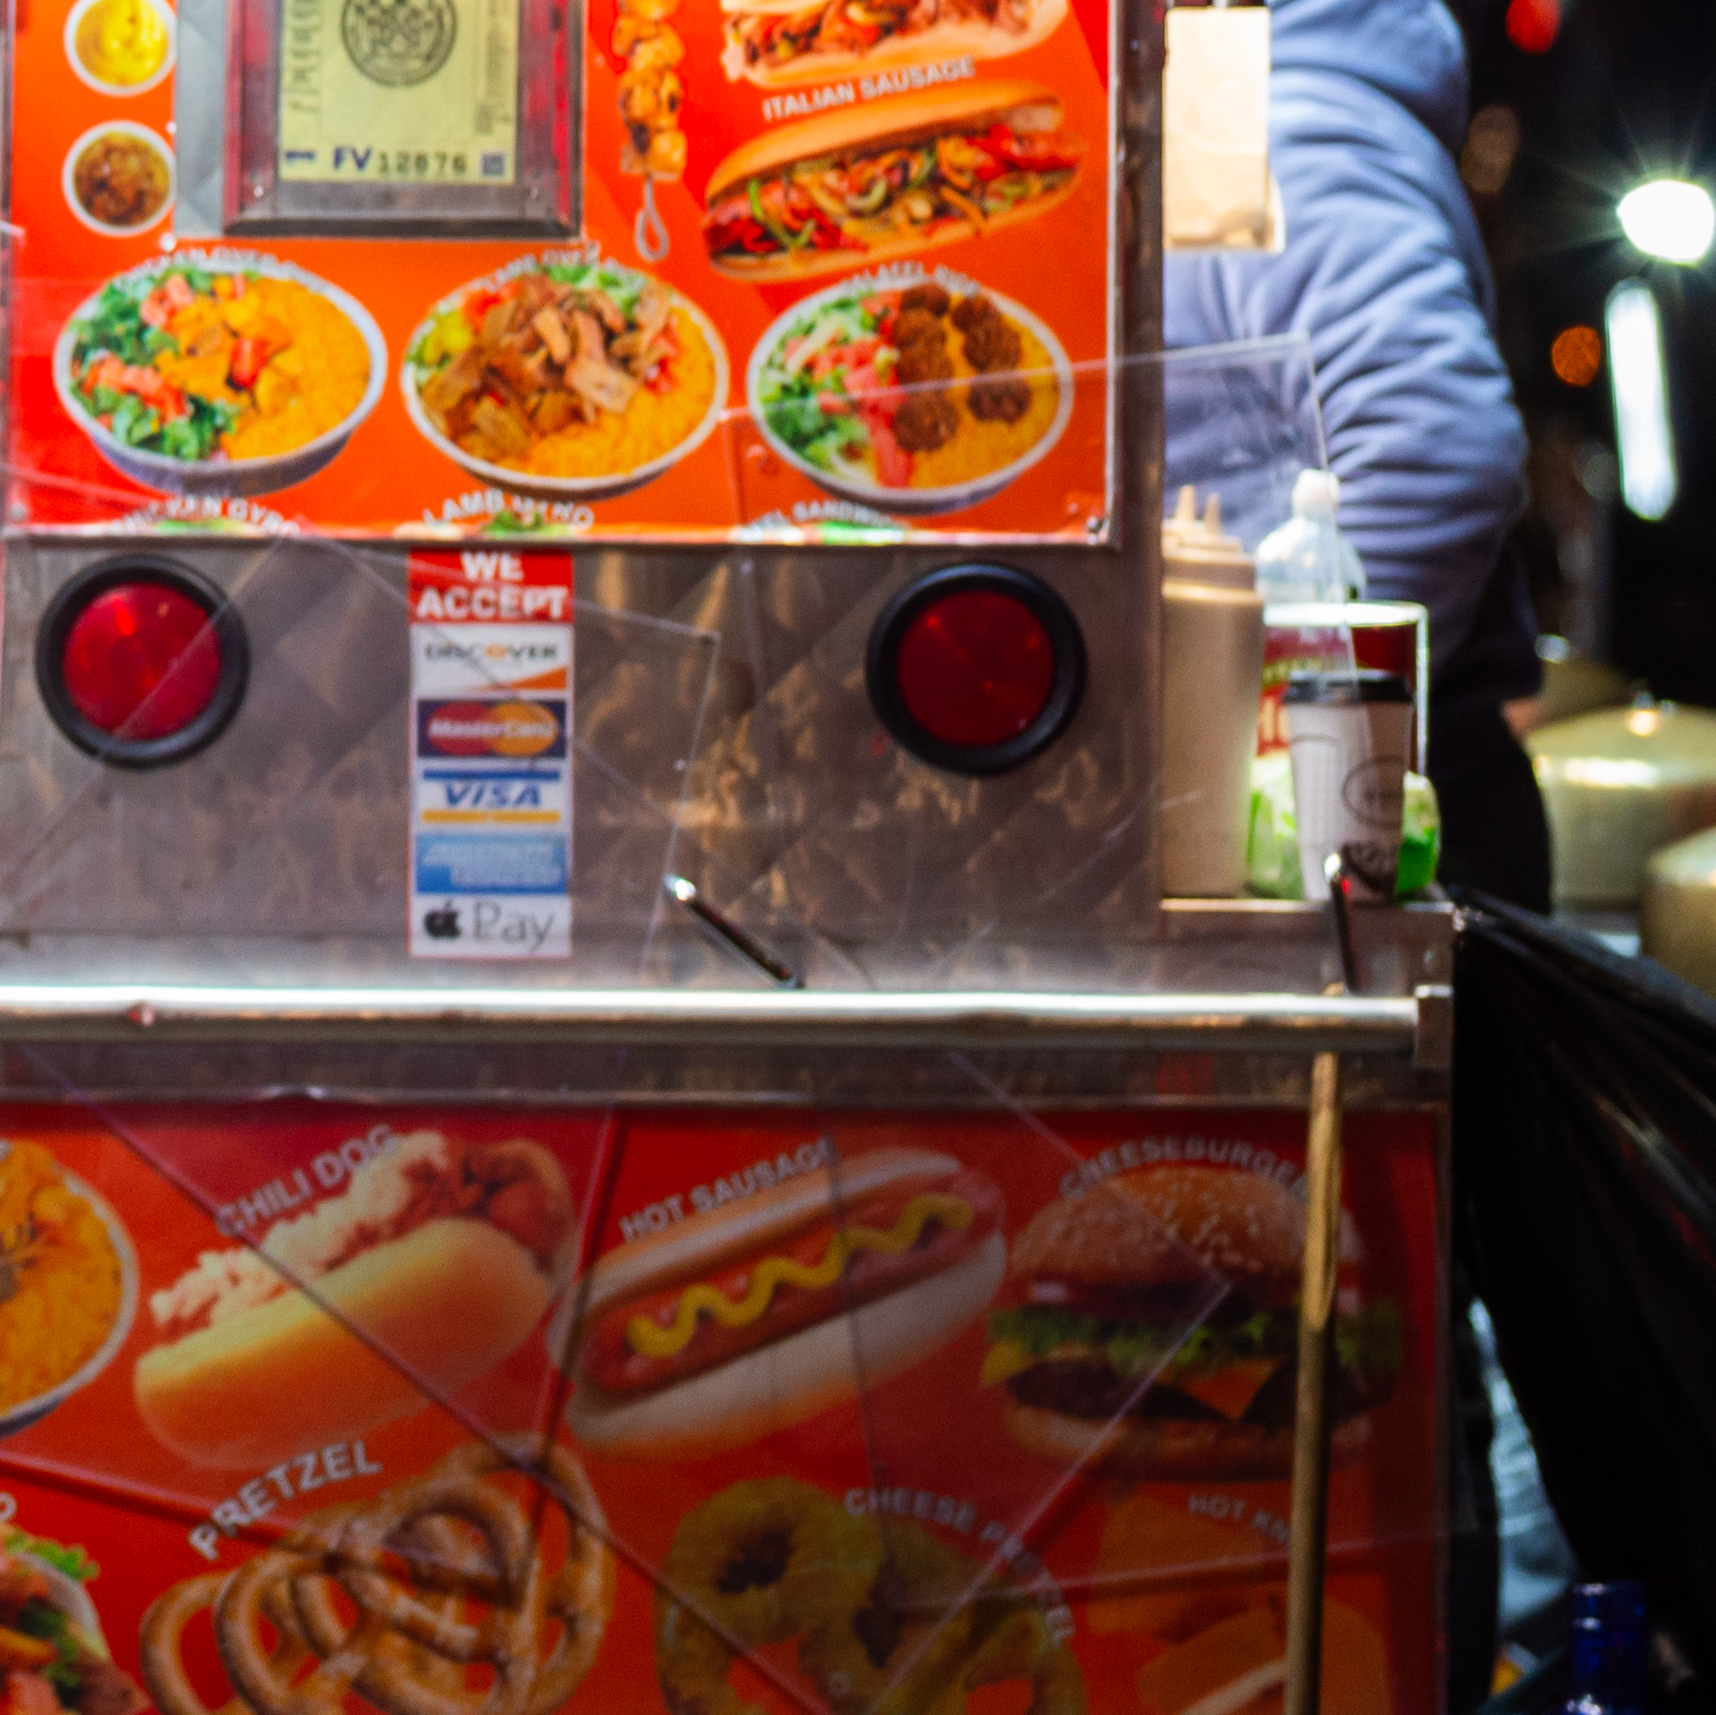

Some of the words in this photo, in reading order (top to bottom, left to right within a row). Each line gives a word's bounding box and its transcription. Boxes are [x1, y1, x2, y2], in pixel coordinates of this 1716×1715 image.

[762, 81, 857, 122] ITALIAN
[860, 55, 977, 102] SAUSAGE
[460, 551, 524, 581] WE
[416, 586, 568, 620] ACCEPT
[443, 783, 542, 809] VISA
[474, 900, 554, 953] Pay
[617, 1191, 686, 1243] HOT
[187, 1439, 384, 1562] PRETZEL
[1187, 1493, 1247, 1522] HOT
